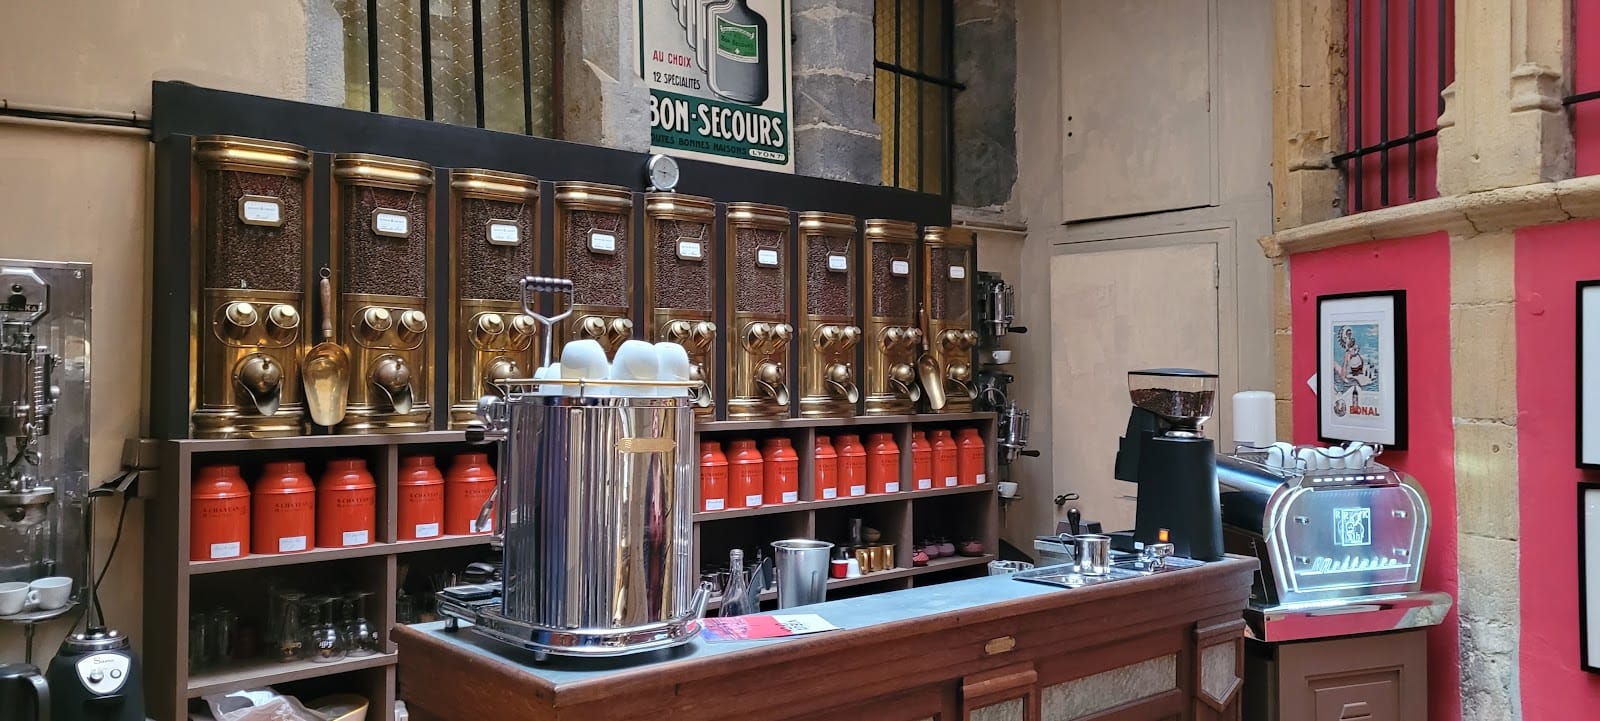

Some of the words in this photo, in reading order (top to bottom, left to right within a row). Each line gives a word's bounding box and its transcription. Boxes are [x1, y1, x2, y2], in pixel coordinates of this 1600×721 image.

[653, 50, 664, 62] AU
[668, 53, 692, 68] CHOIX
[653, 71, 662, 83] 12
[678, 137, 710, 150] BONNES
[713, 143, 747, 156] MAISONS
[752, 150, 775, 159] LYON
